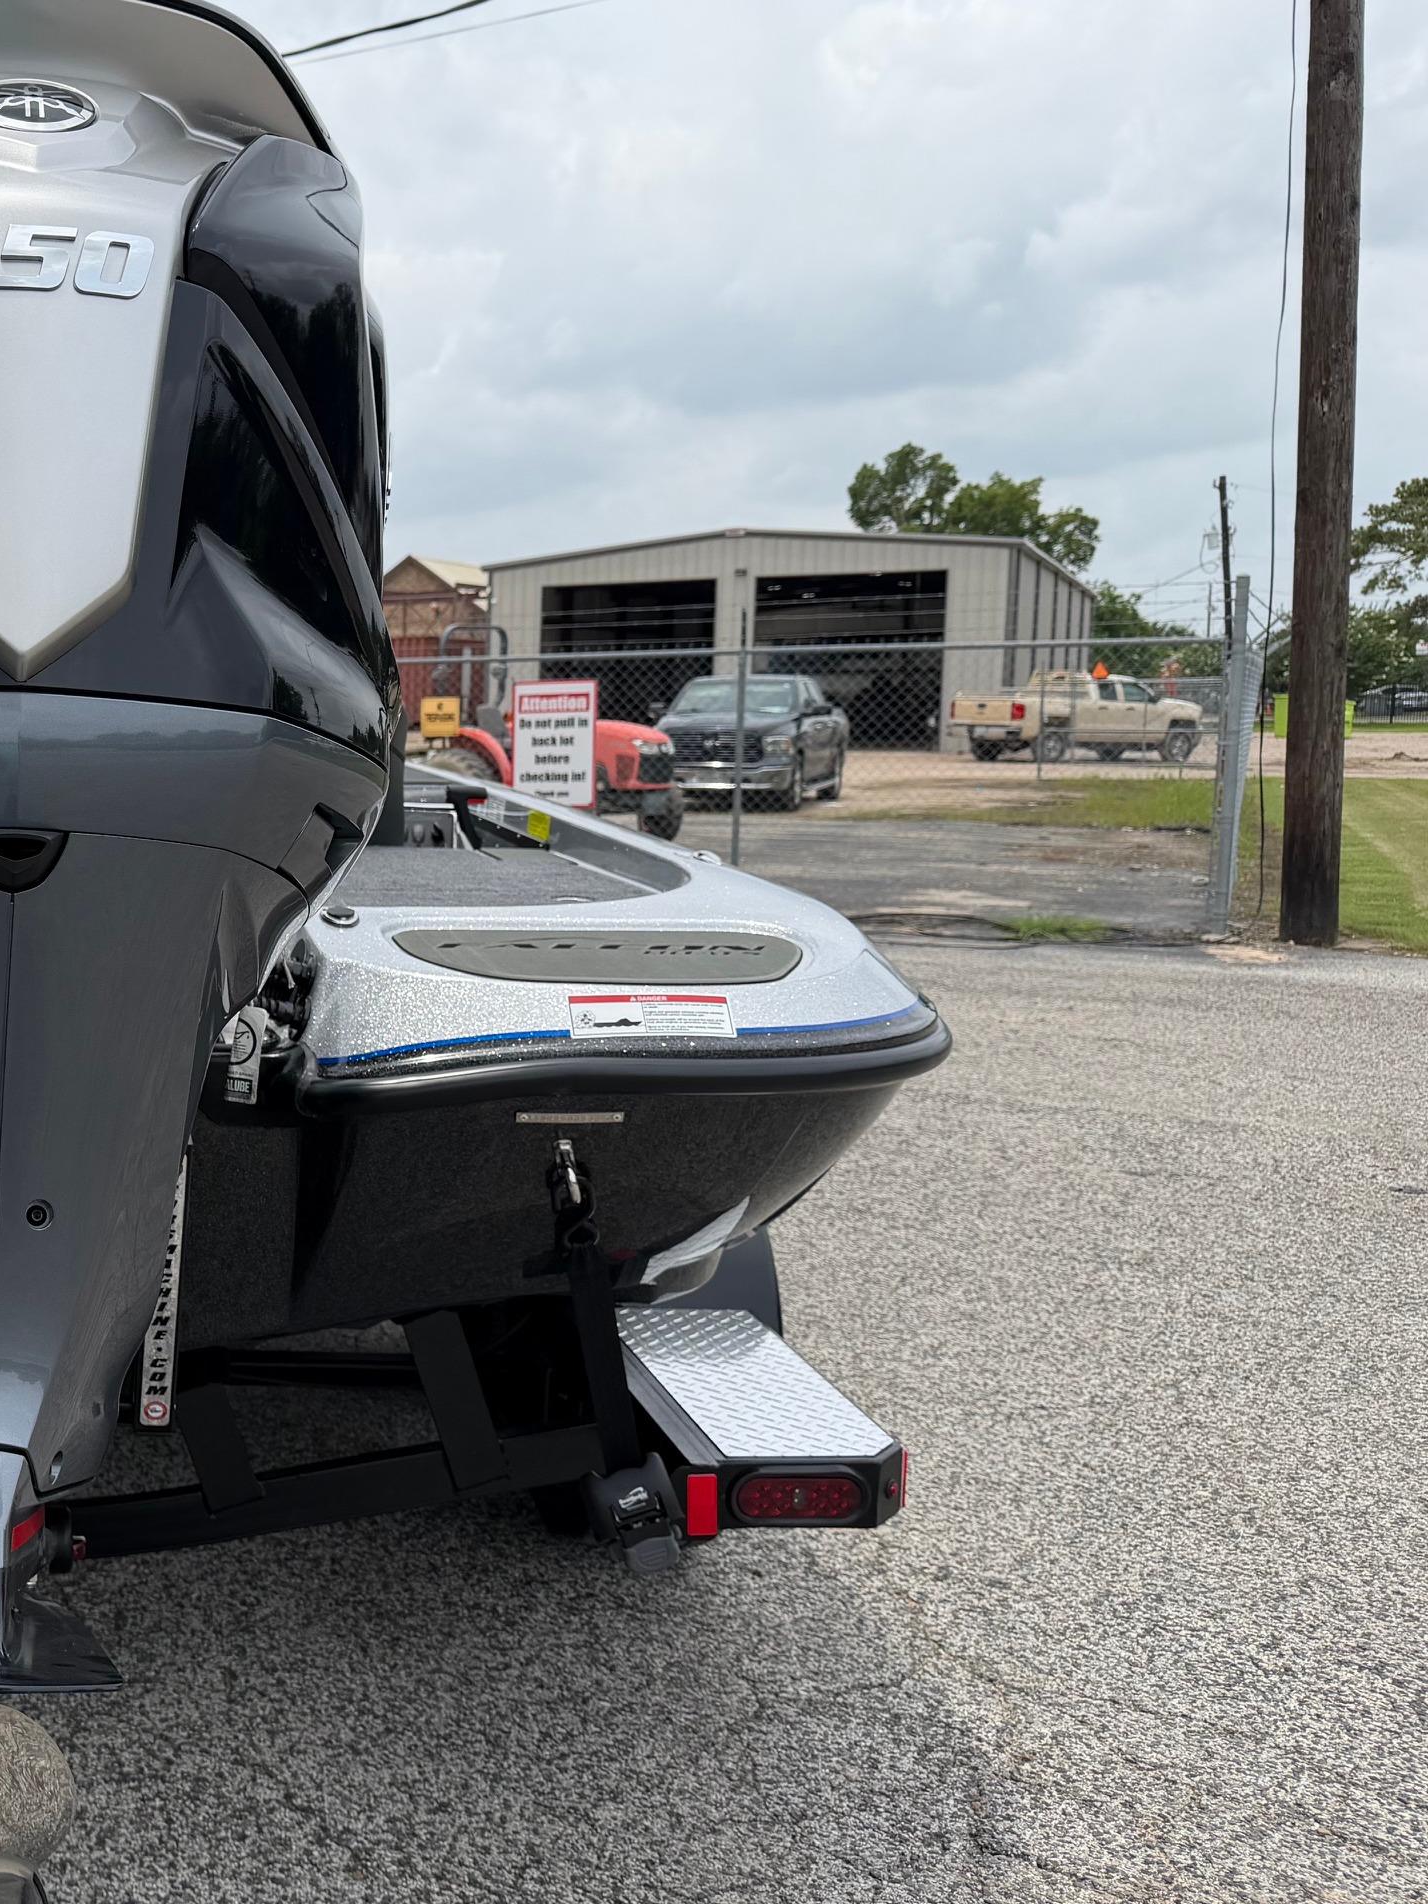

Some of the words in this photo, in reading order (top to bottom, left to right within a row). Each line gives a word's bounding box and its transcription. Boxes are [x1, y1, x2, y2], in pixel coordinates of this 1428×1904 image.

[520, 695, 589, 712] Attention
[519, 719, 532, 728] Do
[534, 719, 552, 728] not
[554, 719, 575, 730] pull
[578, 719, 588, 728] in
[532, 736, 557, 746] back
[560, 736, 574, 746] lot
[534, 754, 570, 765] before
[519, 772, 568, 784] checking
